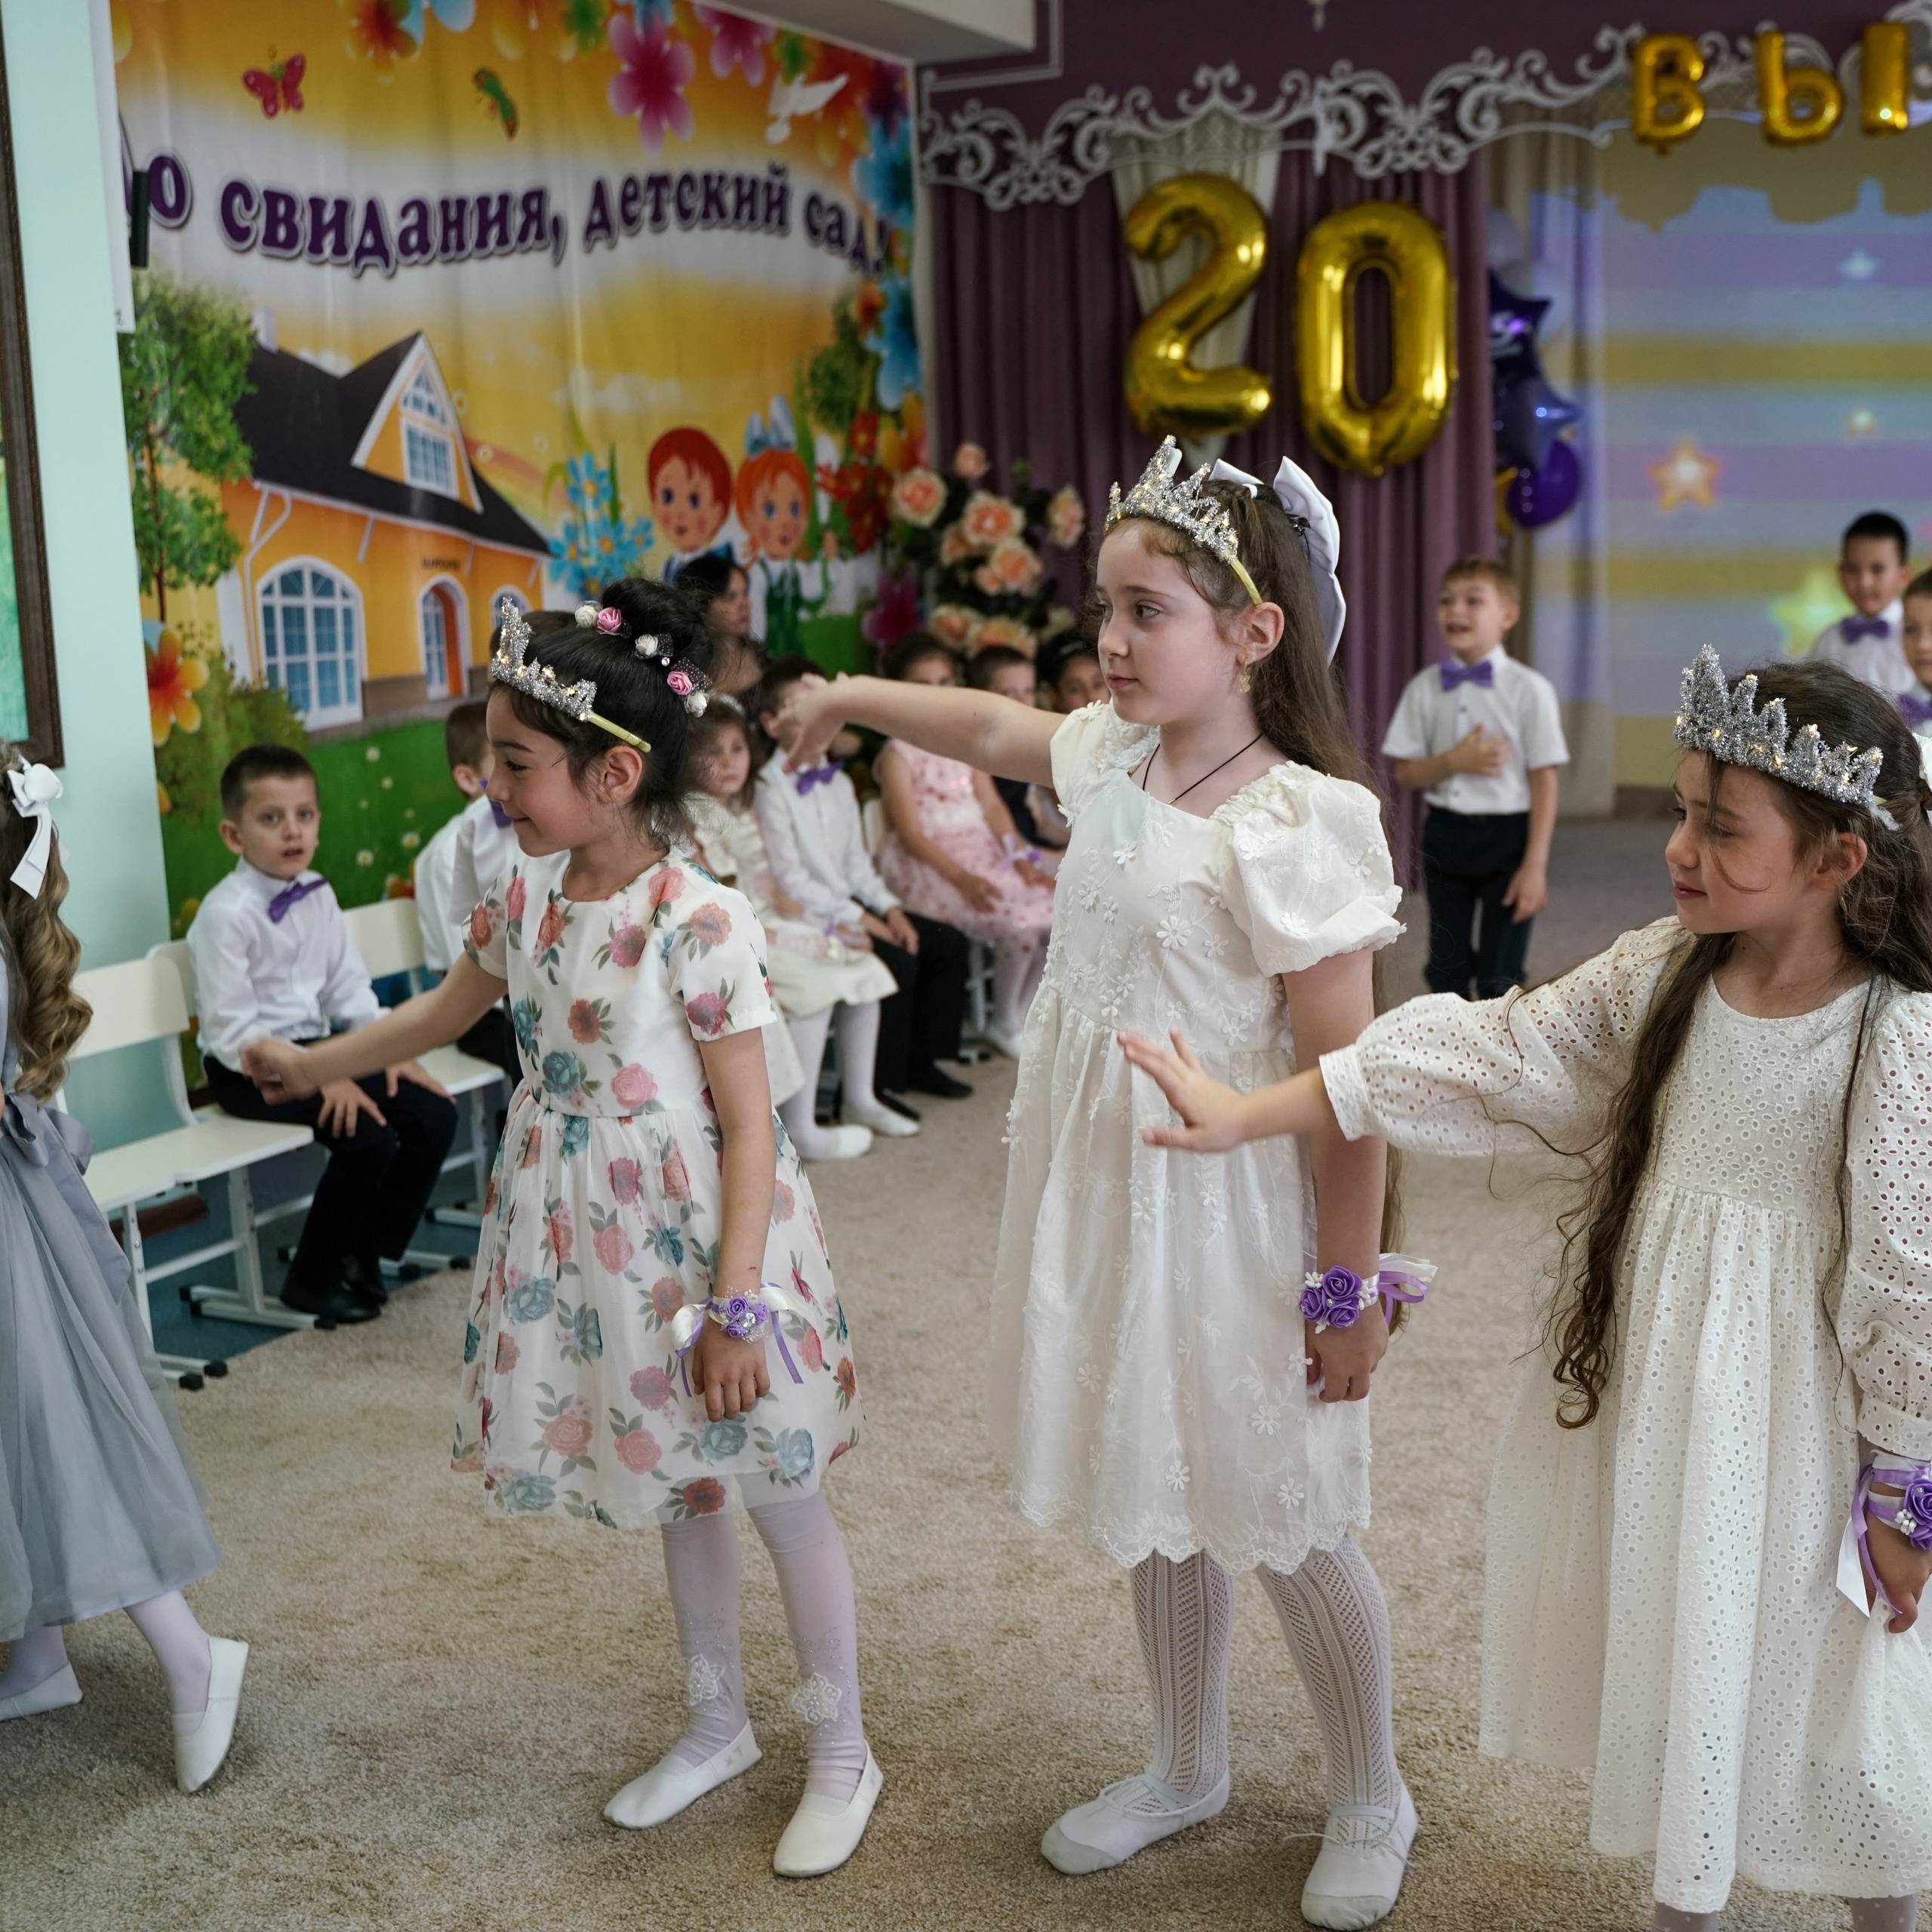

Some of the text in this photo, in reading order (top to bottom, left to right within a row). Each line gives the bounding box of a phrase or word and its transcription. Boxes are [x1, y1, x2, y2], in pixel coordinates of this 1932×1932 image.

[220, 180, 564, 278] свидания,
[584, 162, 790, 251] детский
[1126, 174, 1452, 475] 20
